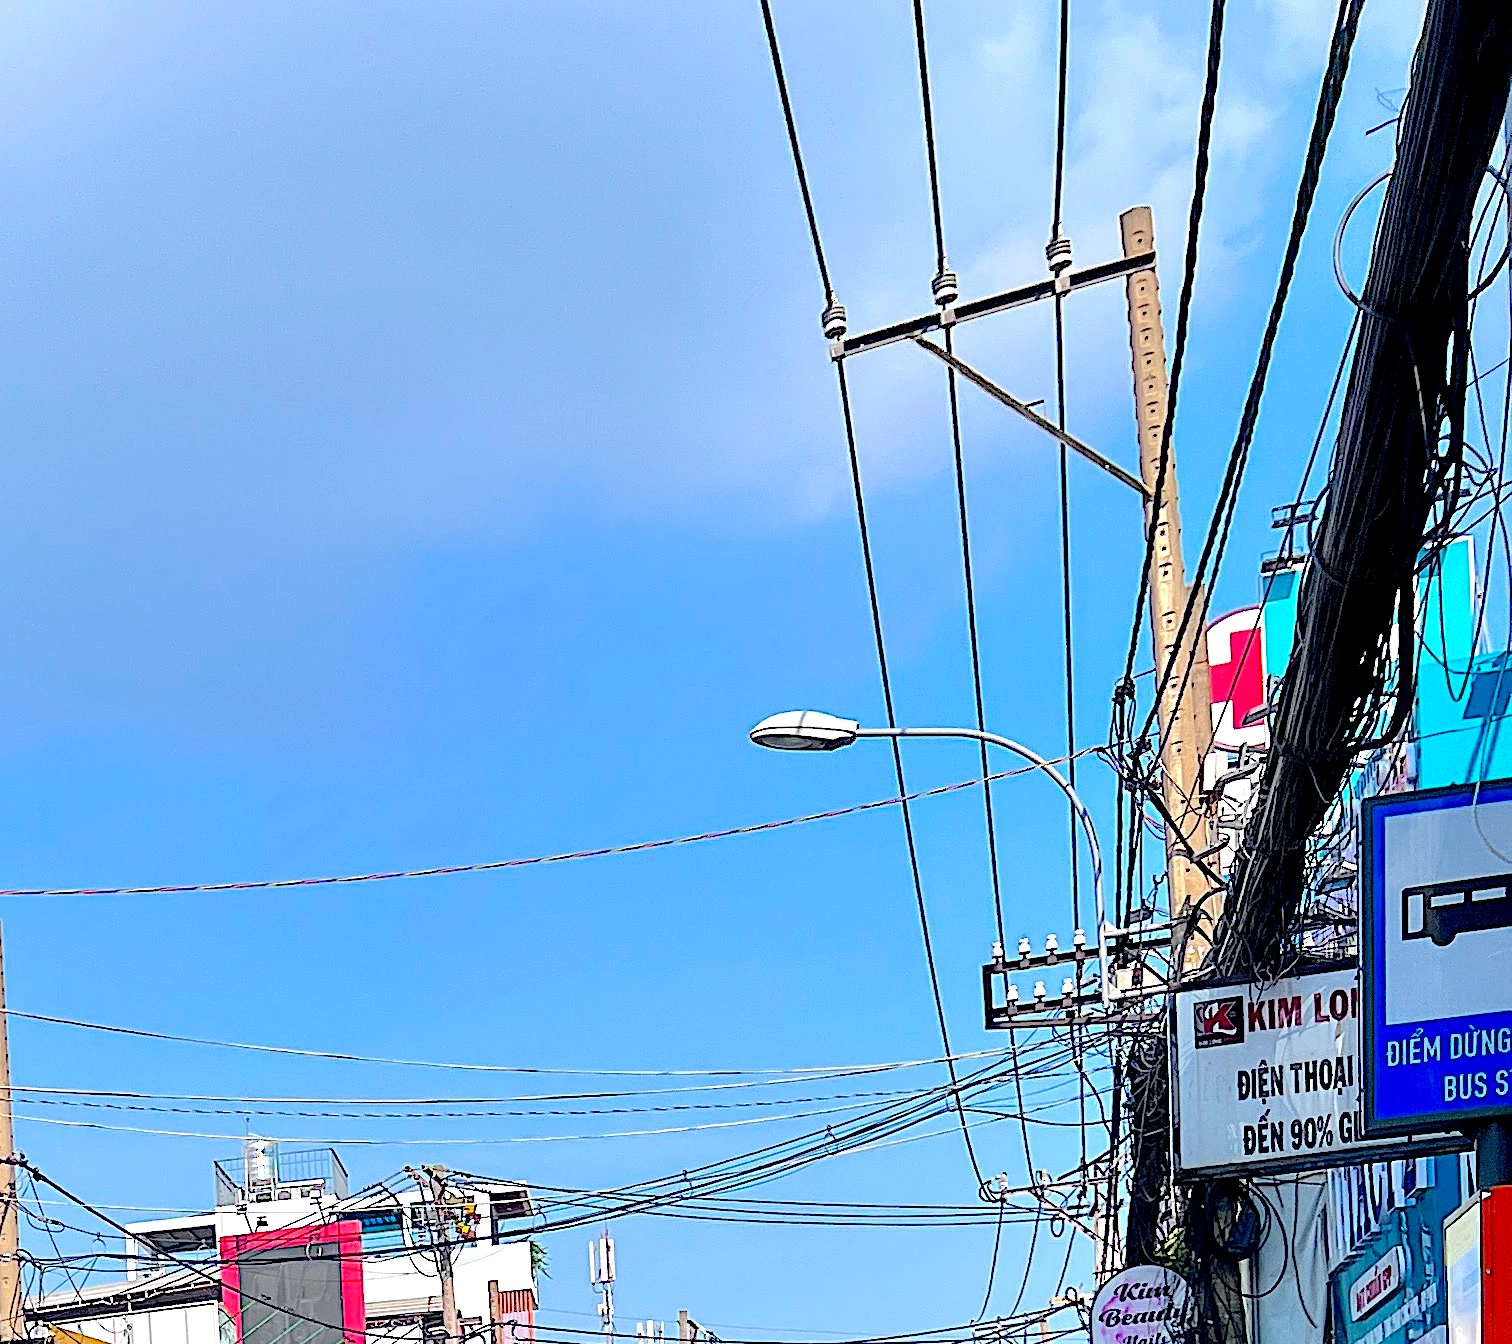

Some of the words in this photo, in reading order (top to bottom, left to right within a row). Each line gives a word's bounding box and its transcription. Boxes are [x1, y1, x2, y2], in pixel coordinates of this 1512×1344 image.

[1247, 994, 1303, 1033] KIM
[1386, 1027, 1441, 1068] ĐIỂM
[1450, 1024, 1512, 1060] DỪNG
[1238, 1059, 1285, 1105] ĐIỆN
[1289, 1054, 1355, 1097] THOẠI
[1444, 1071, 1488, 1102] BUS
[1243, 1108, 1285, 1156] ĐẾN
[1291, 1113, 1334, 1149] 90%
[1338, 1110, 1362, 1144] GI
[1113, 1282, 1171, 1302] Kim
